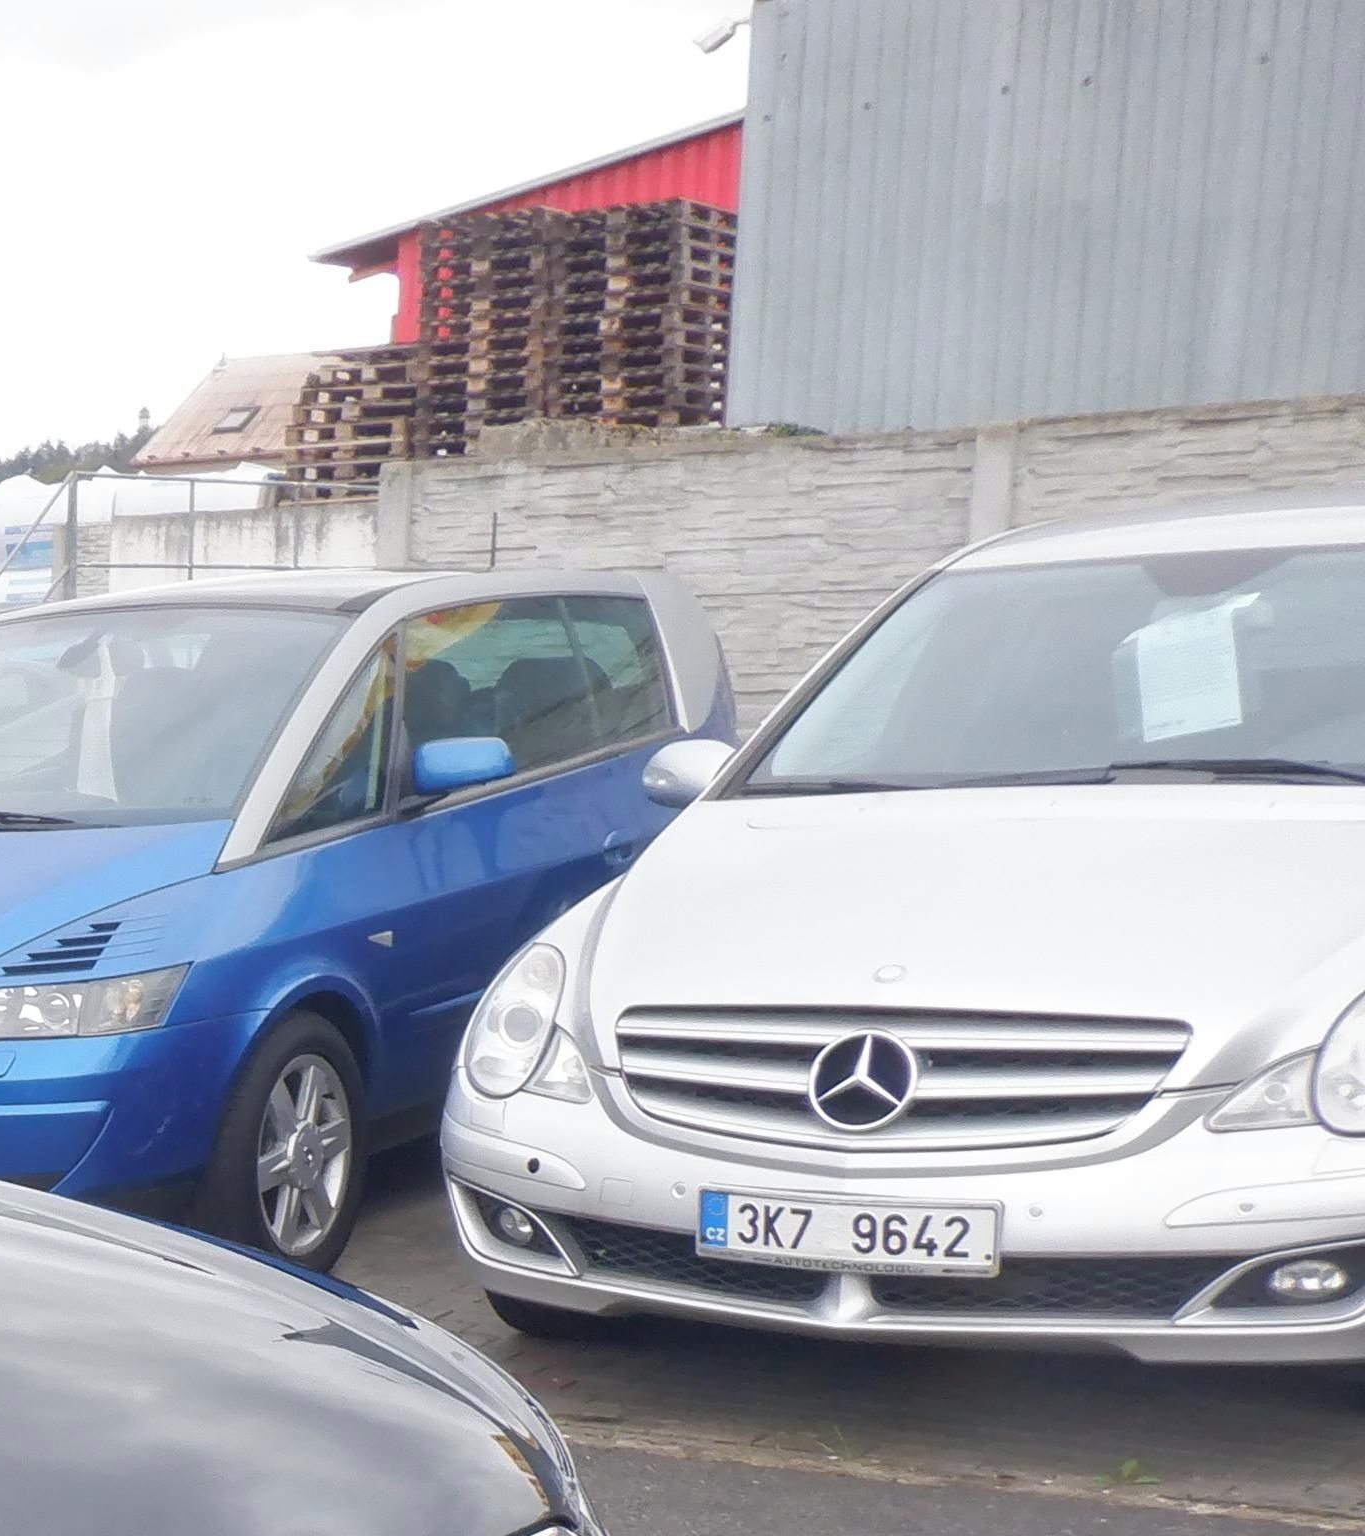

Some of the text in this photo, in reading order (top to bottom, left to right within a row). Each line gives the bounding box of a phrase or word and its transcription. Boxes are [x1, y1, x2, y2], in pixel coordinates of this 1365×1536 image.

[705, 1227, 726, 1241] CZ
[737, 1203, 971, 1258] 3K7 9642
